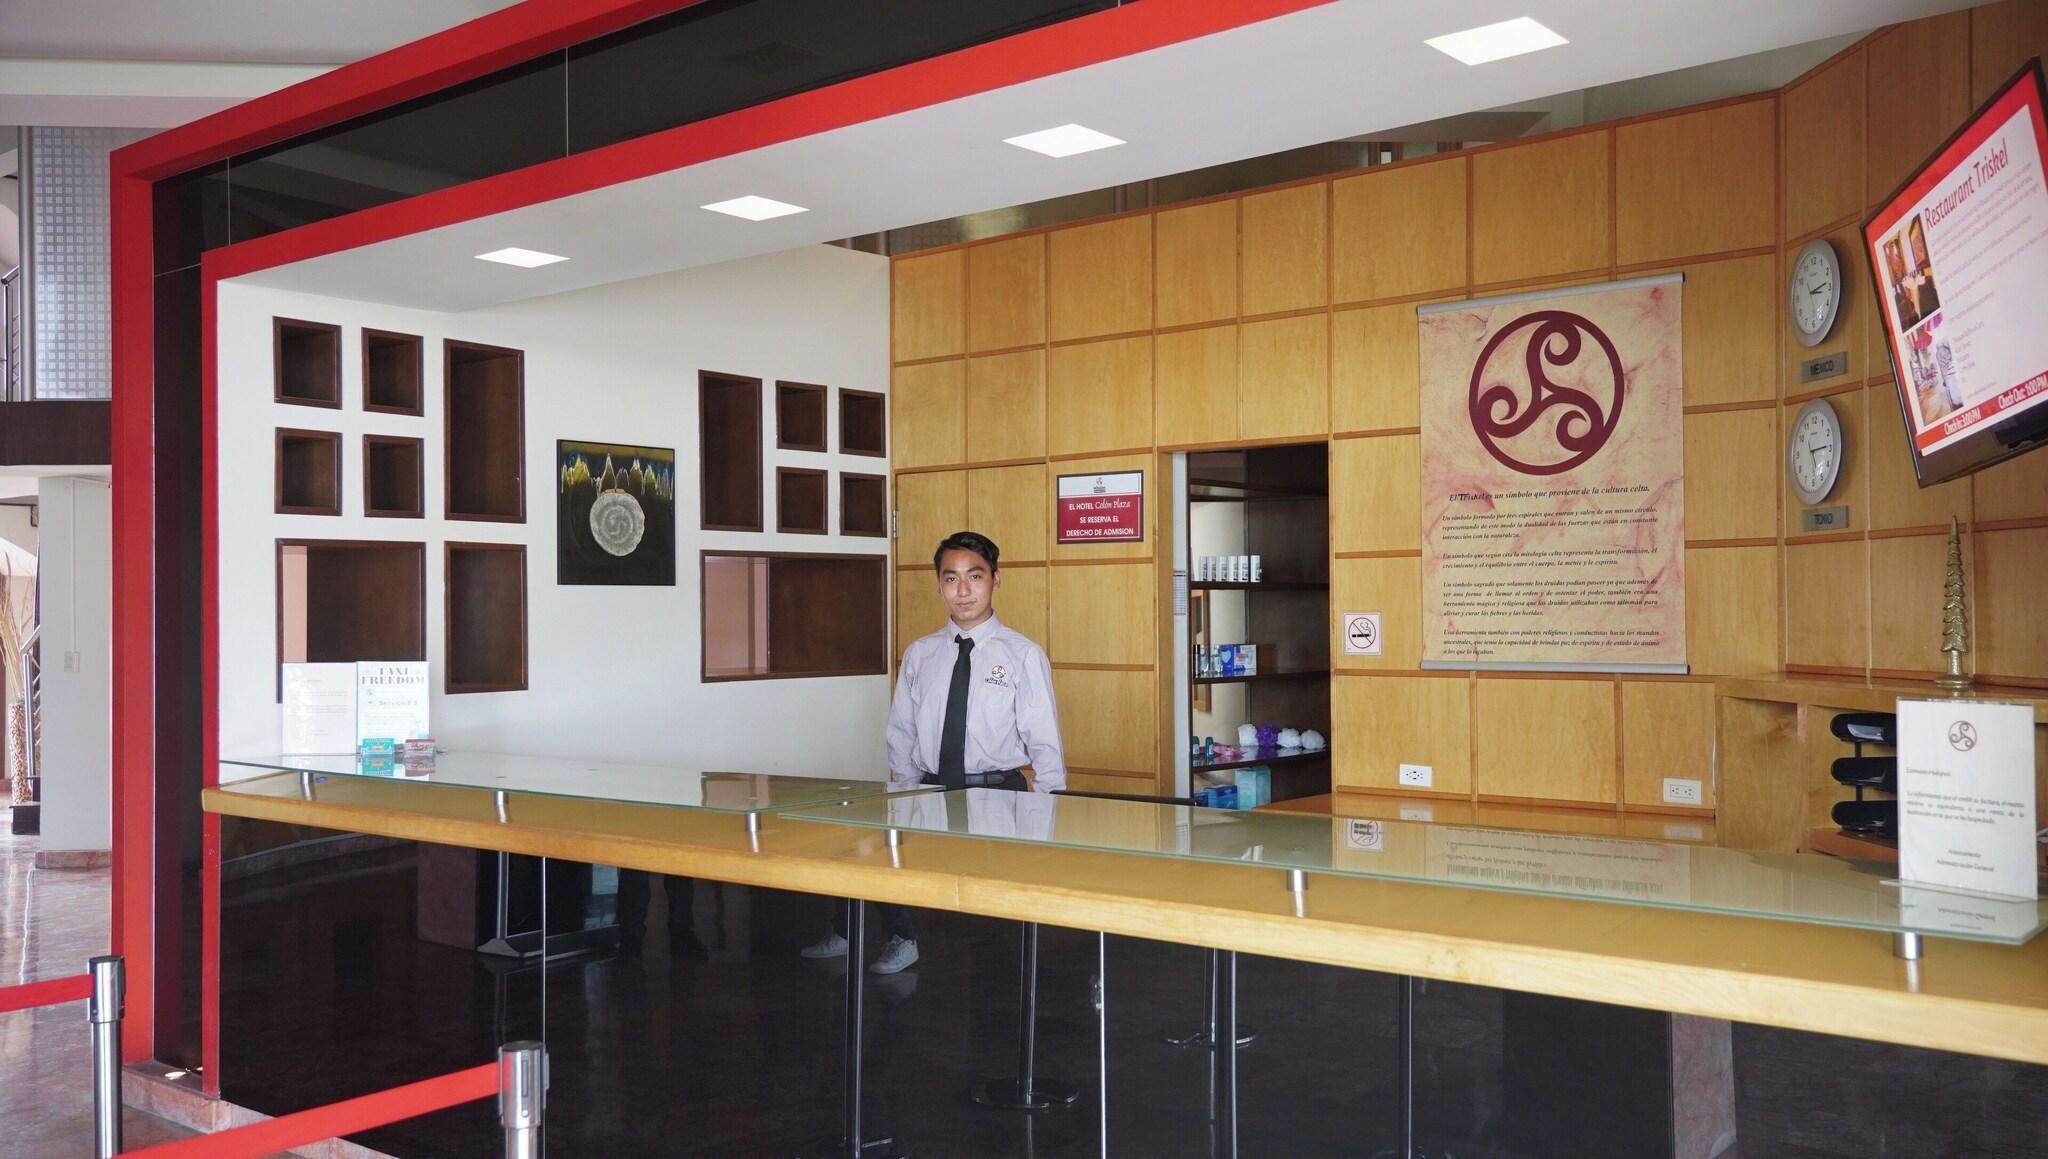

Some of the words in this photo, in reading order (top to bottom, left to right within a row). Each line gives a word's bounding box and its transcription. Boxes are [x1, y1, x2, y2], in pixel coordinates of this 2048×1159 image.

[1924, 176, 1974, 230] Restaurant
[1505, 490, 1532, 498] símbolo
[1534, 491, 1547, 499] que
[1548, 489, 1580, 499] proviene
[1581, 487, 1590, 495] de
[1592, 487, 1599, 495] la
[1601, 485, 1628, 494] cultura
[1630, 484, 1649, 493] celta.
[1076, 502, 1094, 510] HOTEL
[1113, 498, 1130, 508] Plaza
[378, 667, 408, 675] TAXI
[362, 676, 424, 685] FREEDOM
